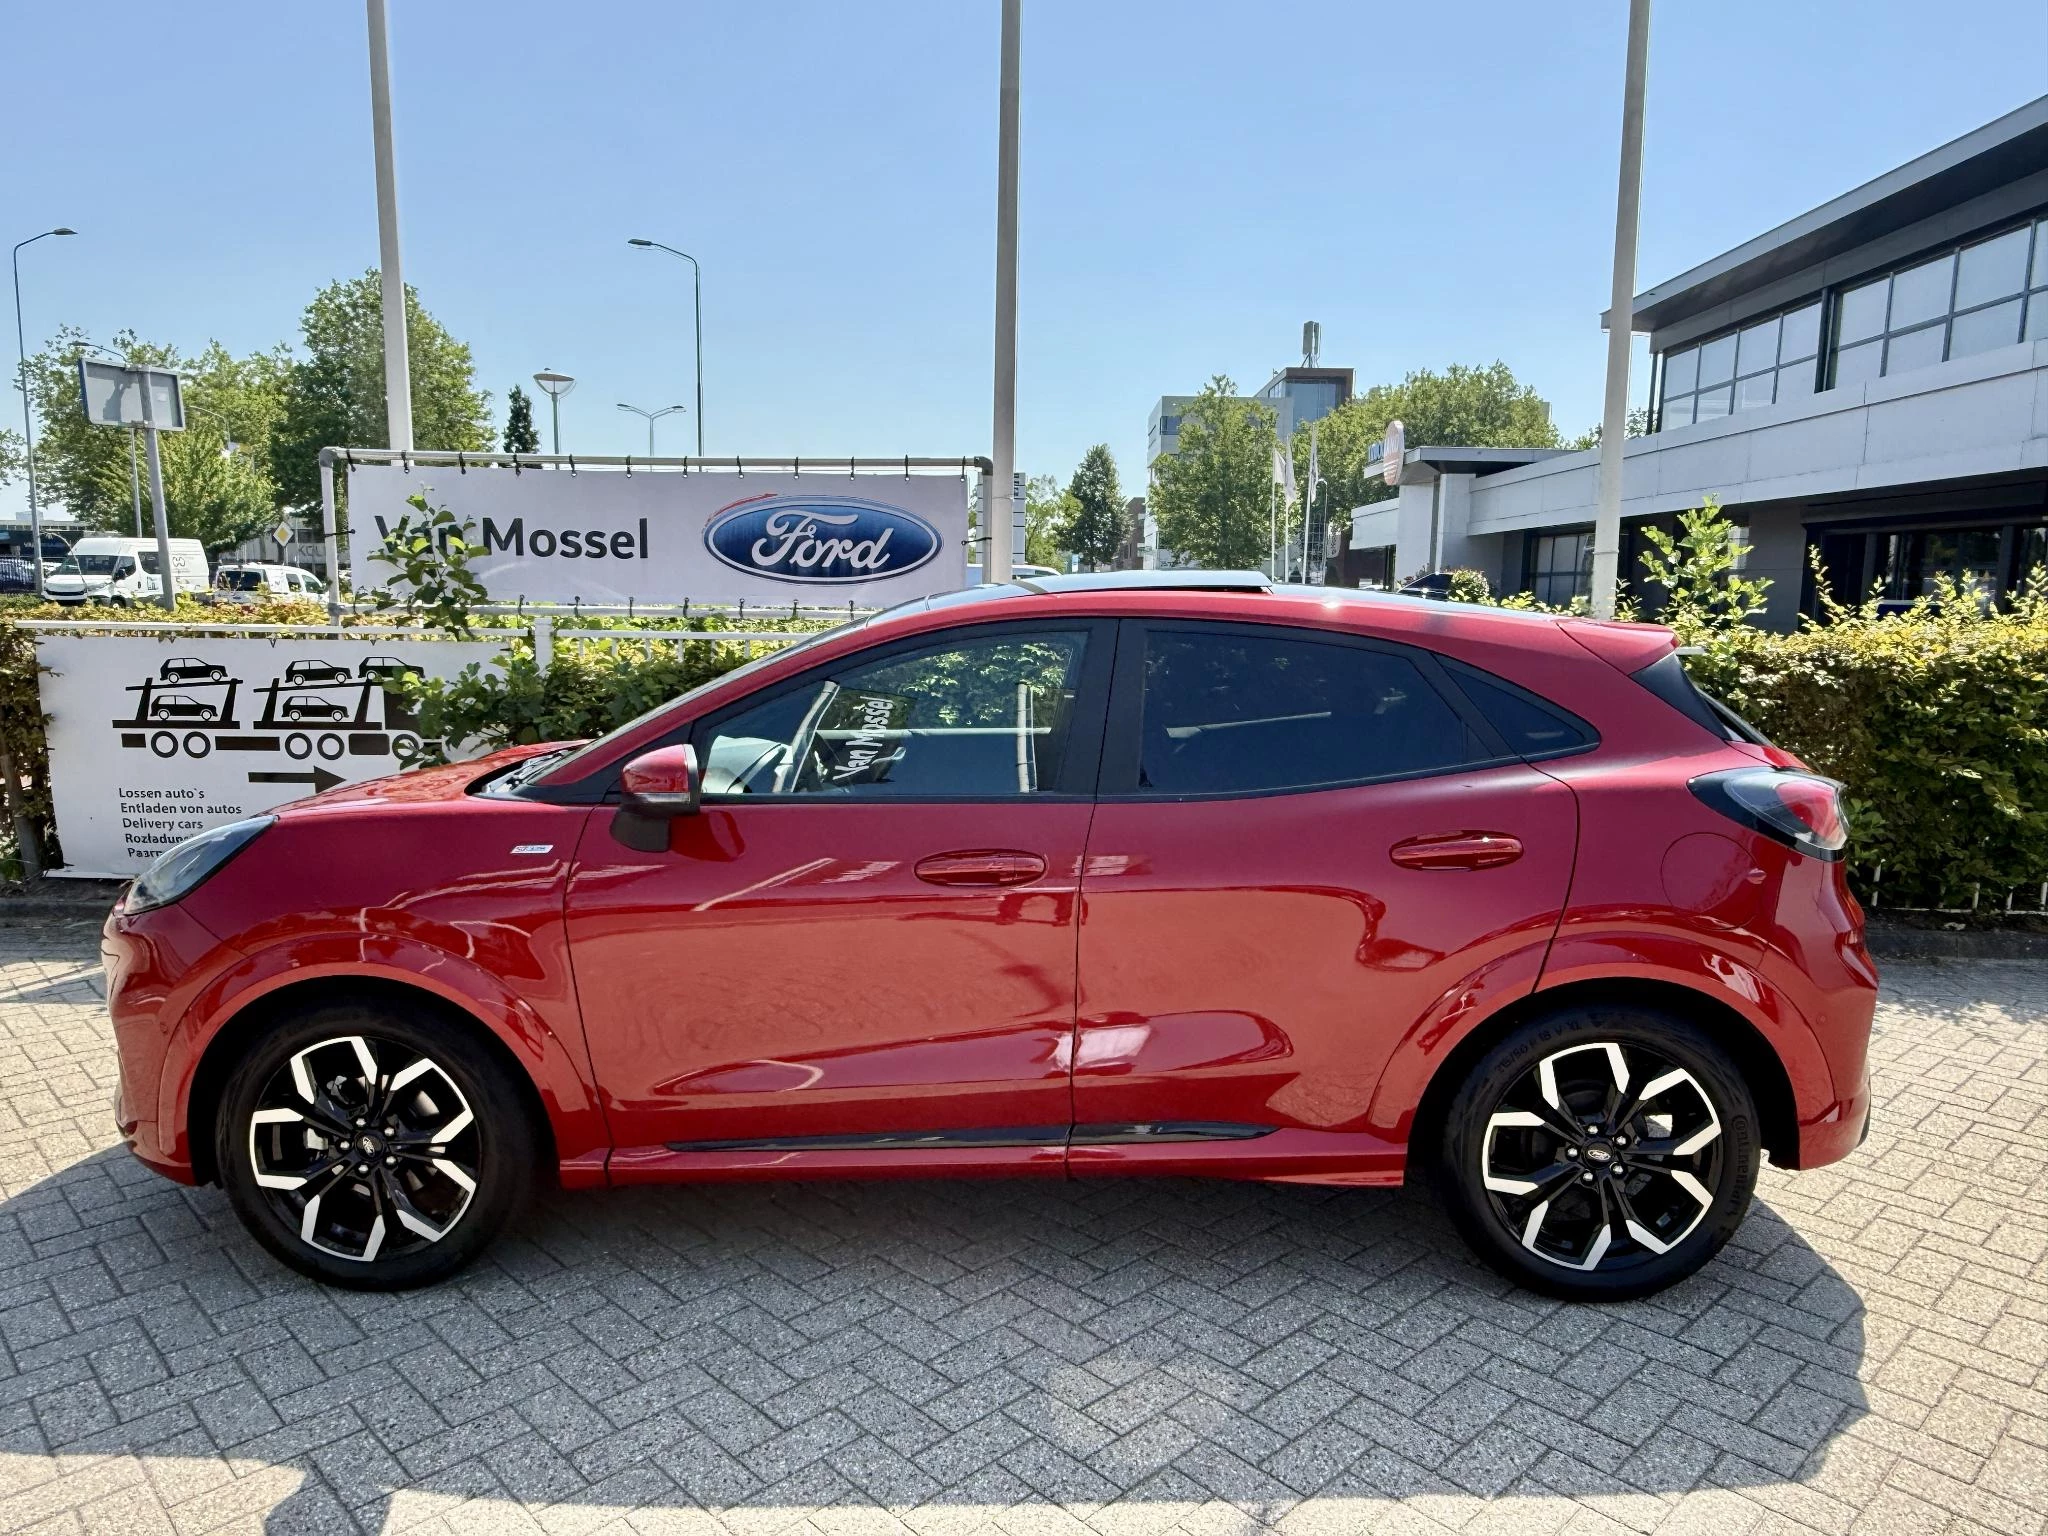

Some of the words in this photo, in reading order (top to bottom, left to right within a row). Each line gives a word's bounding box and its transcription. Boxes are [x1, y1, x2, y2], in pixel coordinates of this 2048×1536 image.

[482, 517, 649, 560] Mossel
[751, 509, 894, 569] Ford
[832, 750, 879, 780] Van
[118, 788, 162, 799] Lossen
[120, 802, 177, 814] Entladen
[180, 805, 204, 814] von
[206, 804, 242, 814] autos
[122, 818, 175, 831] Delivery
[178, 820, 204, 829] cars
